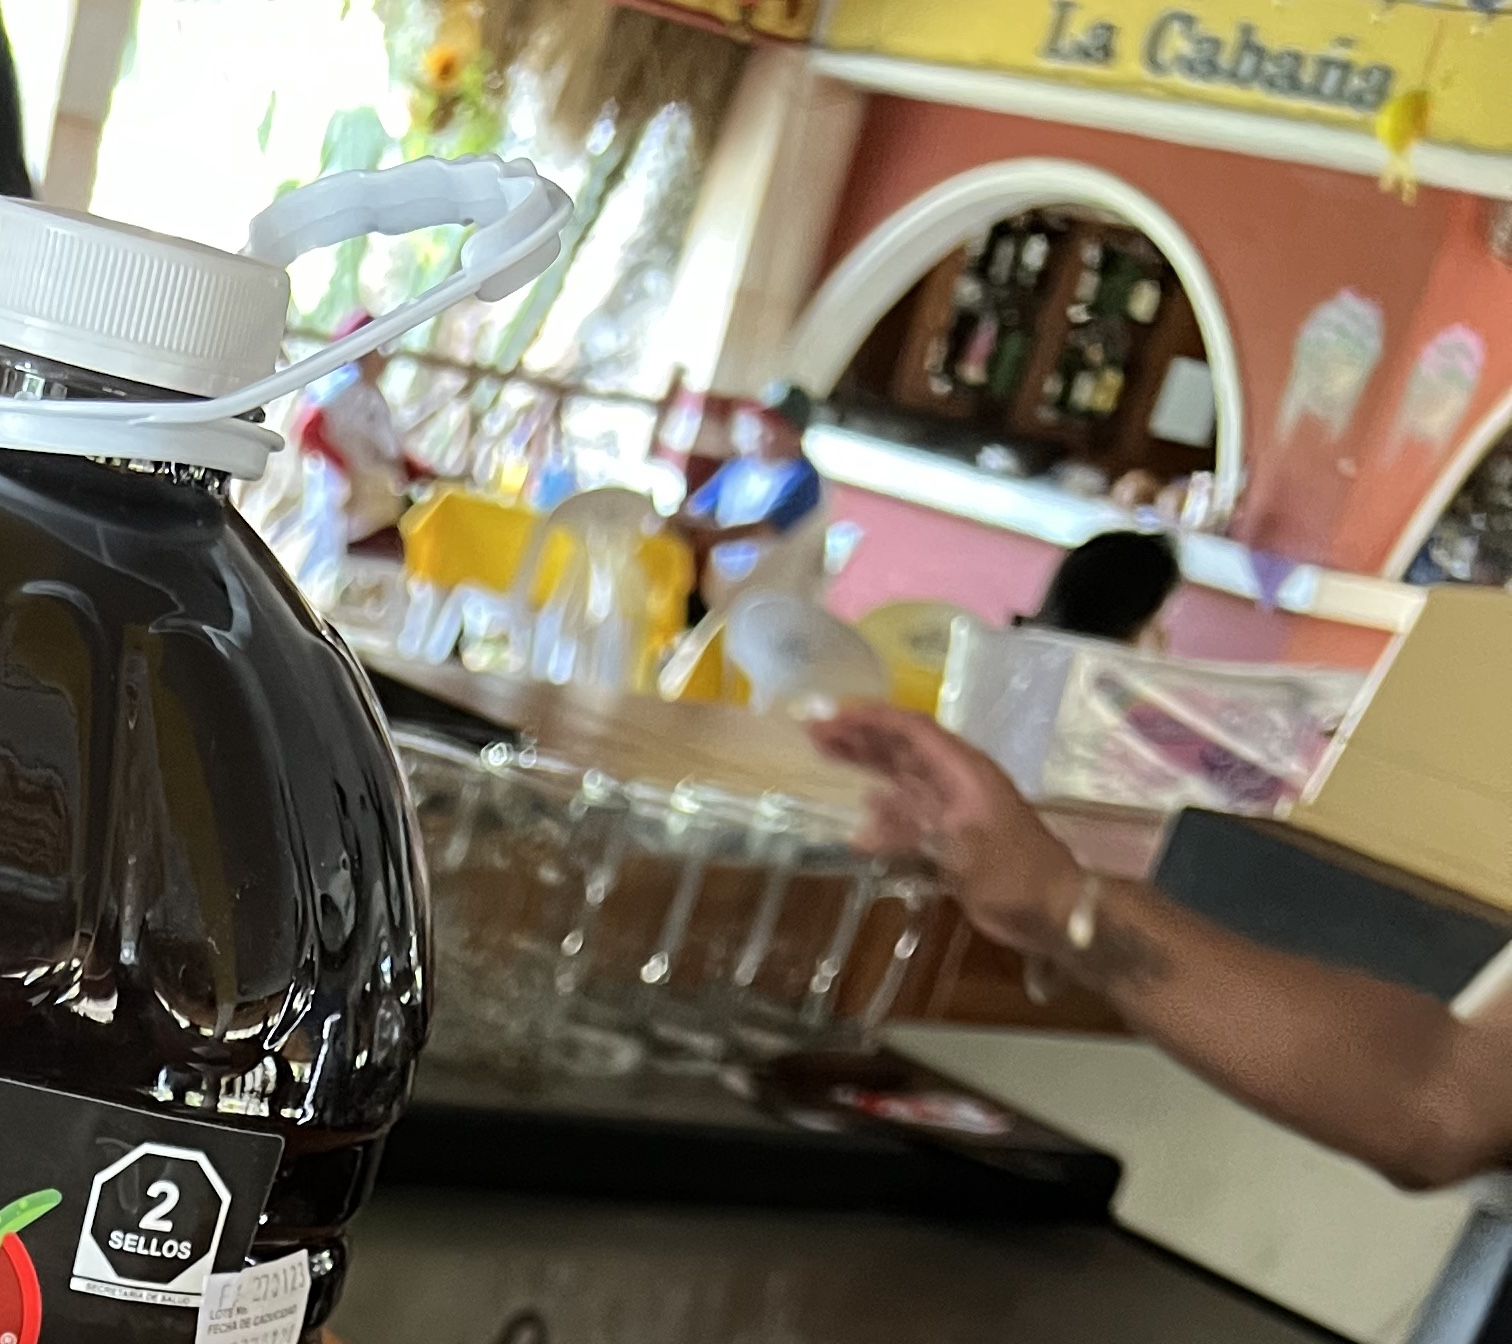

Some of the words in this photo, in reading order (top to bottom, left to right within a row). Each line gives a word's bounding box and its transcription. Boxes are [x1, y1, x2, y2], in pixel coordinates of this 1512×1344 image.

[1040, 0, 1116, 64] La
[1141, 10, 1394, 112] Cabaña
[139, 1180, 181, 1232] 2
[108, 1230, 192, 1260] SELLOS
